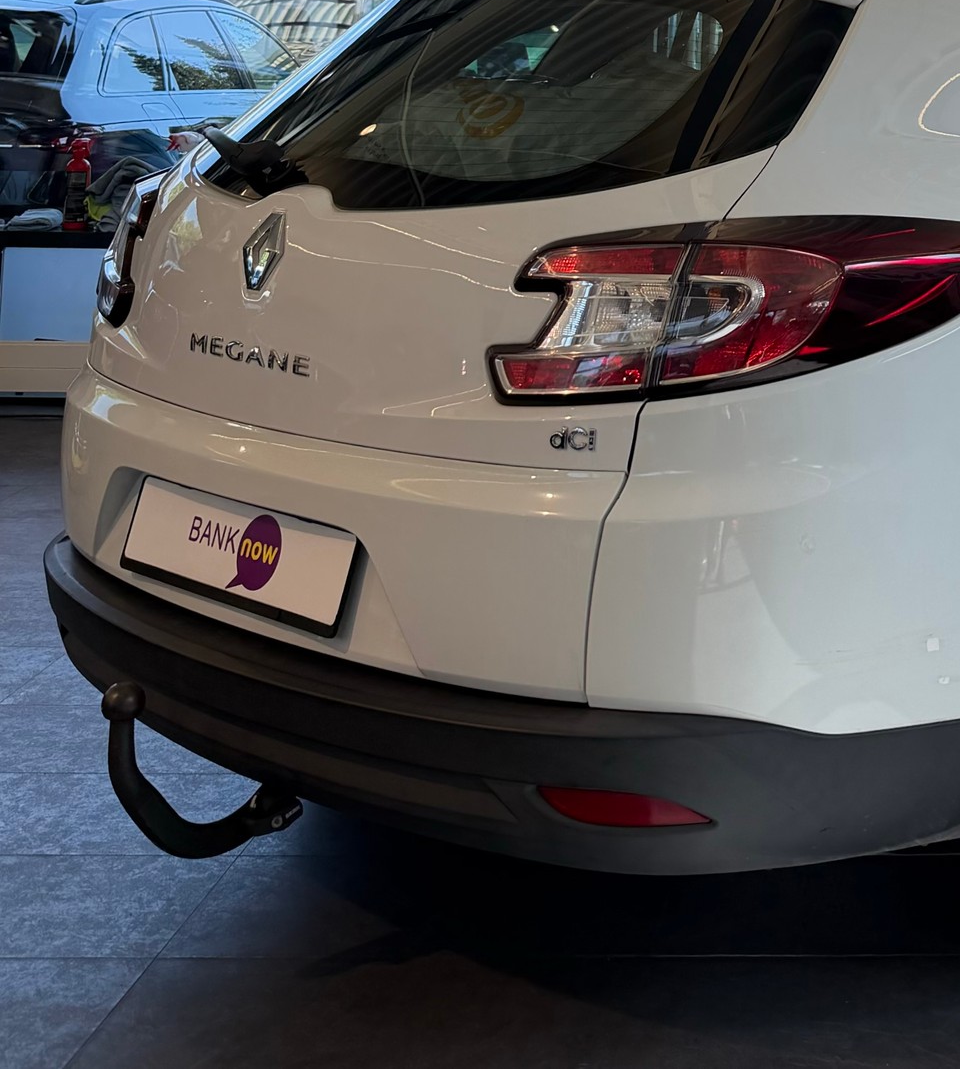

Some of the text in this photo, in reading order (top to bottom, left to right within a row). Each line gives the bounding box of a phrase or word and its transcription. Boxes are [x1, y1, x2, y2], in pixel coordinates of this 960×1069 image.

[189, 332, 311, 378] MEGANE
[188, 515, 279, 565] BANK now
